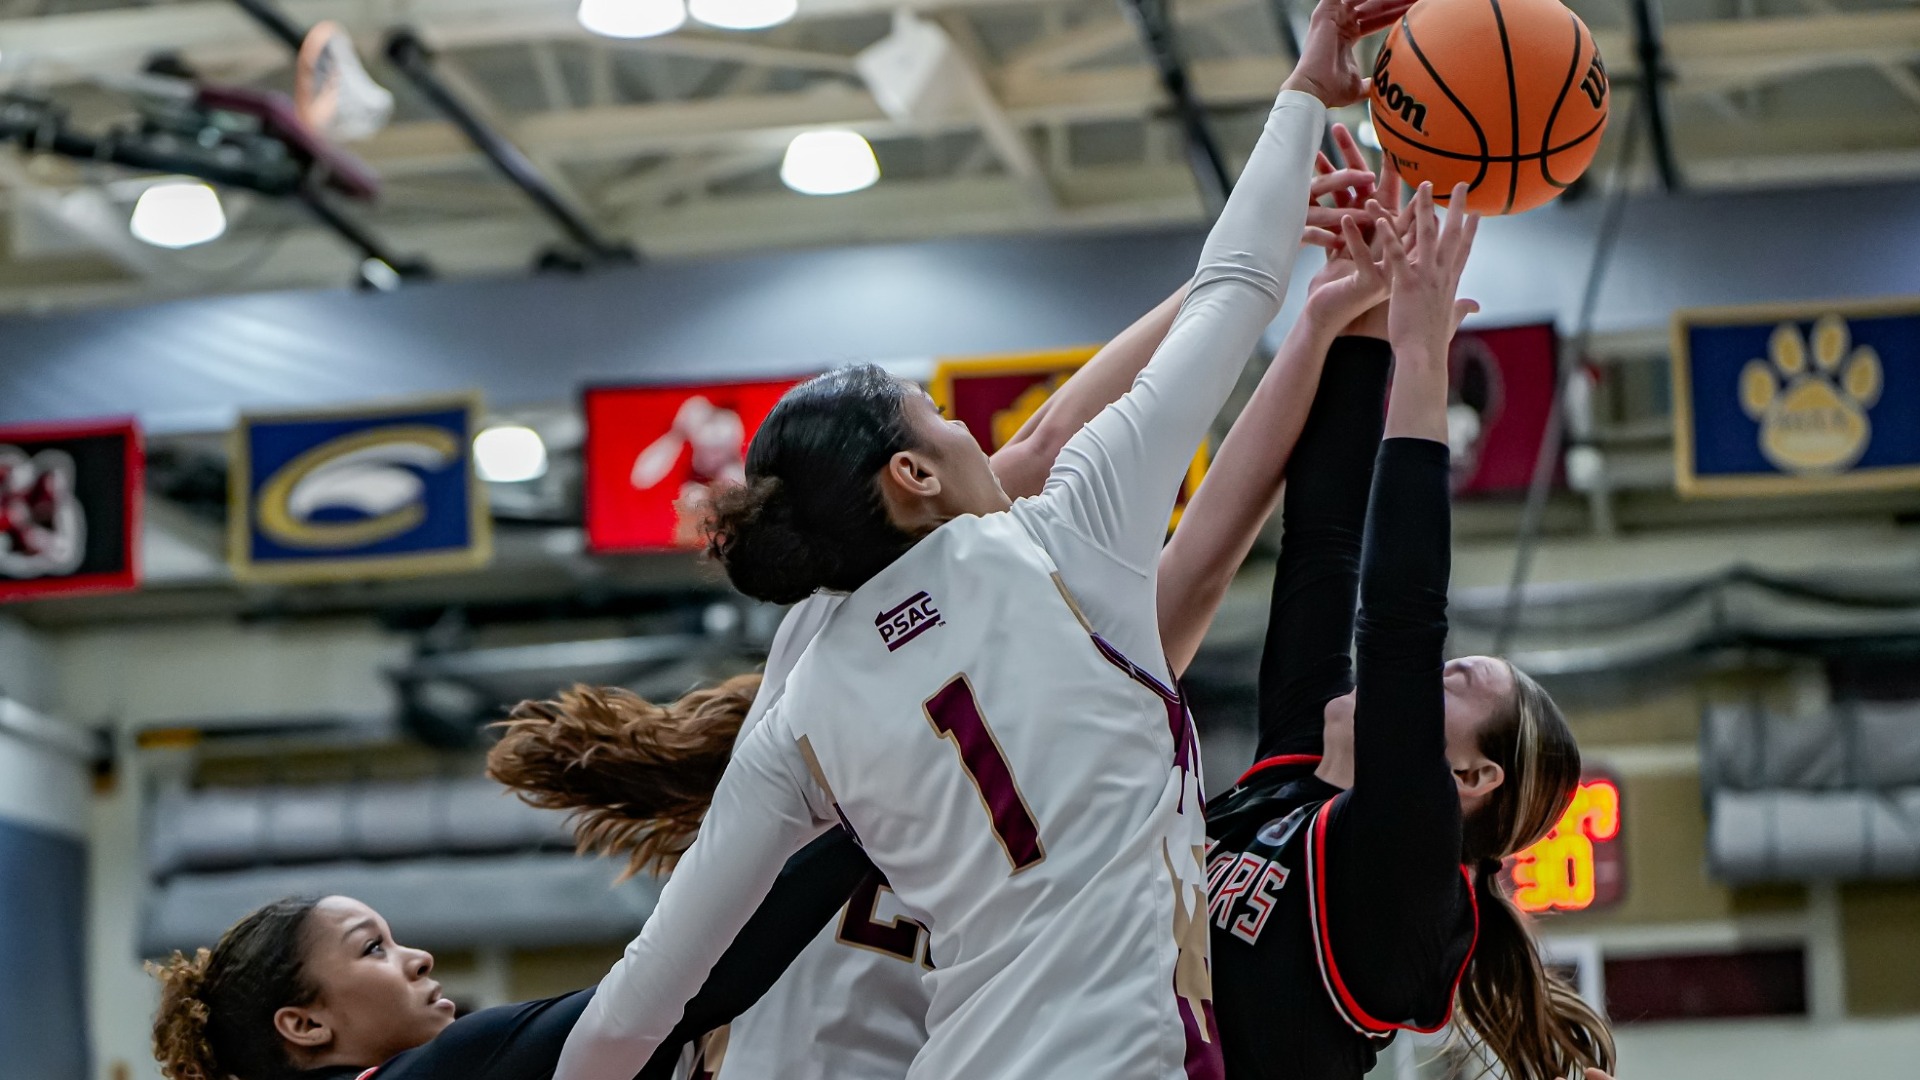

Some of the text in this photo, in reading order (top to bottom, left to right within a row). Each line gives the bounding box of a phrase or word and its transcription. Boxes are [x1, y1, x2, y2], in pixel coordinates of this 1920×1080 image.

[1373, 47, 1428, 133] lson
[878, 597, 939, 644] PSAC
[921, 671, 1047, 877] 1
[1205, 836, 1290, 946] ORS
